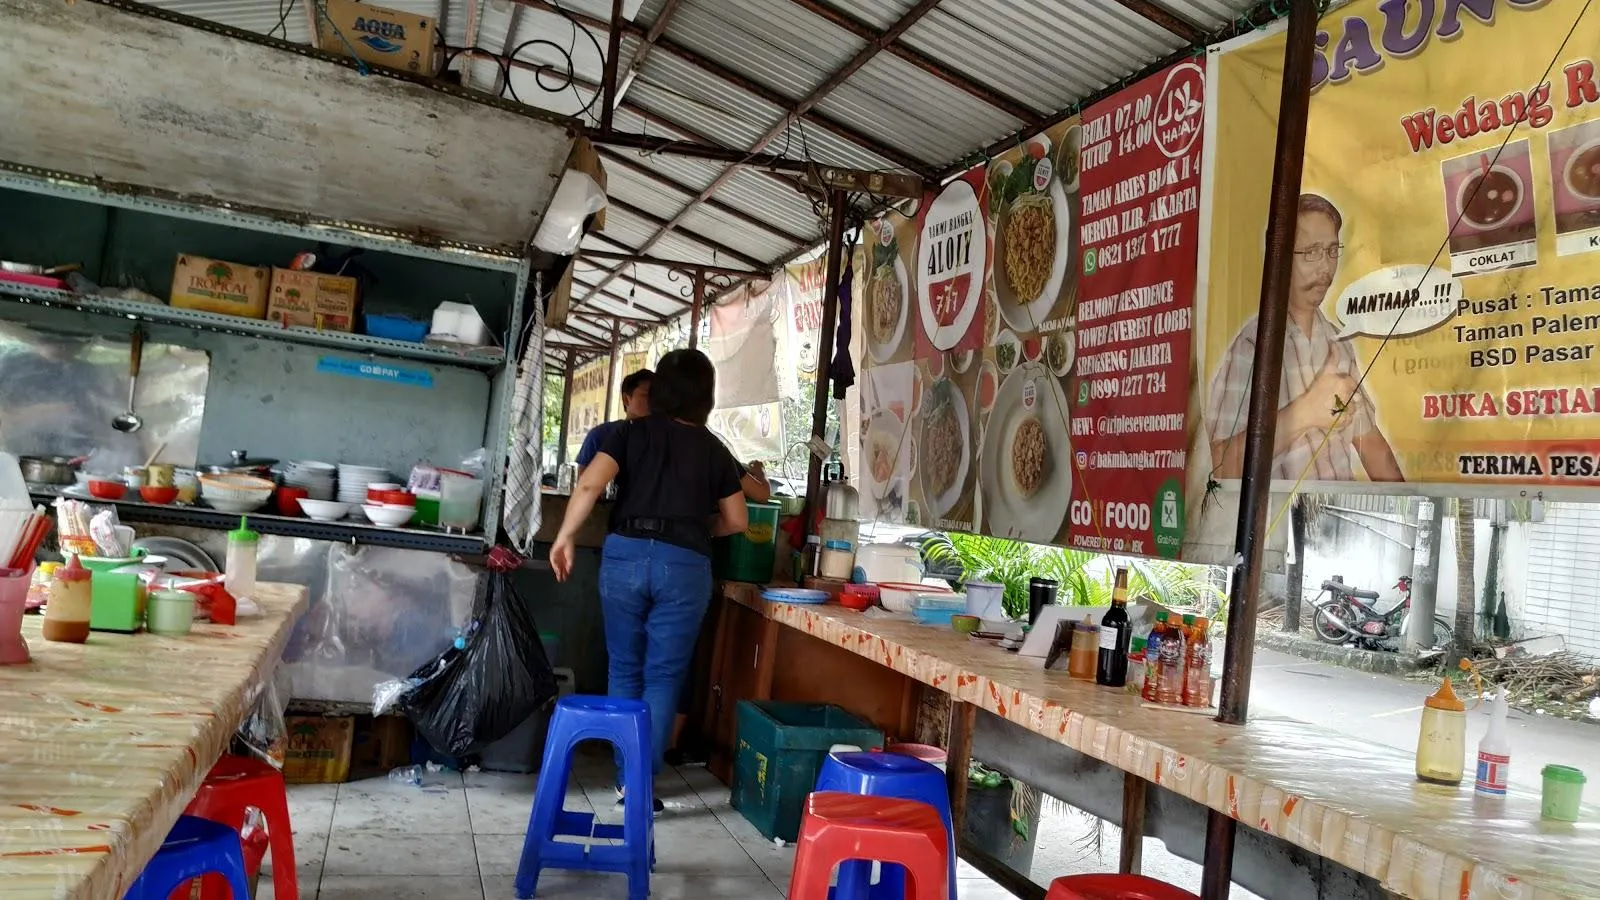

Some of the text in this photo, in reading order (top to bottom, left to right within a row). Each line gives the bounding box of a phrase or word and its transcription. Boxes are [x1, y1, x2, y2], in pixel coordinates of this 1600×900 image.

[352, 17, 406, 40] AQUA
[1309, 0, 1545, 91] AUN
[1081, 94, 1152, 148] BUKA 07.00
[1401, 82, 1553, 152] Wedang
[1081, 120, 1153, 172] TUTUP 14.00
[1082, 186, 1112, 217] TAMAN
[1114, 174, 1145, 205] ARIES
[1081, 214, 1118, 246] MERUYA
[1099, 242, 1122, 268] 0821
[1151, 222, 1182, 253] 1777
[1469, 250, 1516, 267] COKLAT
[1078, 294, 1119, 322] BELMONT
[1457, 293, 1518, 316] Pusat
[1078, 324, 1108, 349] TOWER
[1454, 324, 1523, 343] Taman
[1128, 342, 1173, 372] JAKARTA
[1470, 347, 1517, 368] BSD
[1525, 344, 1594, 363] Pasar
[1090, 371, 1167, 400] 0899 1277 734
[1424, 392, 1498, 418] BUKA
[1071, 416, 1094, 436] NEW!
[1459, 455, 1543, 476] TERIMA
[1549, 454, 1600, 476] PES
[1070, 500, 1151, 531] GO FOOD
[1073, 534, 1101, 548] POWERED
